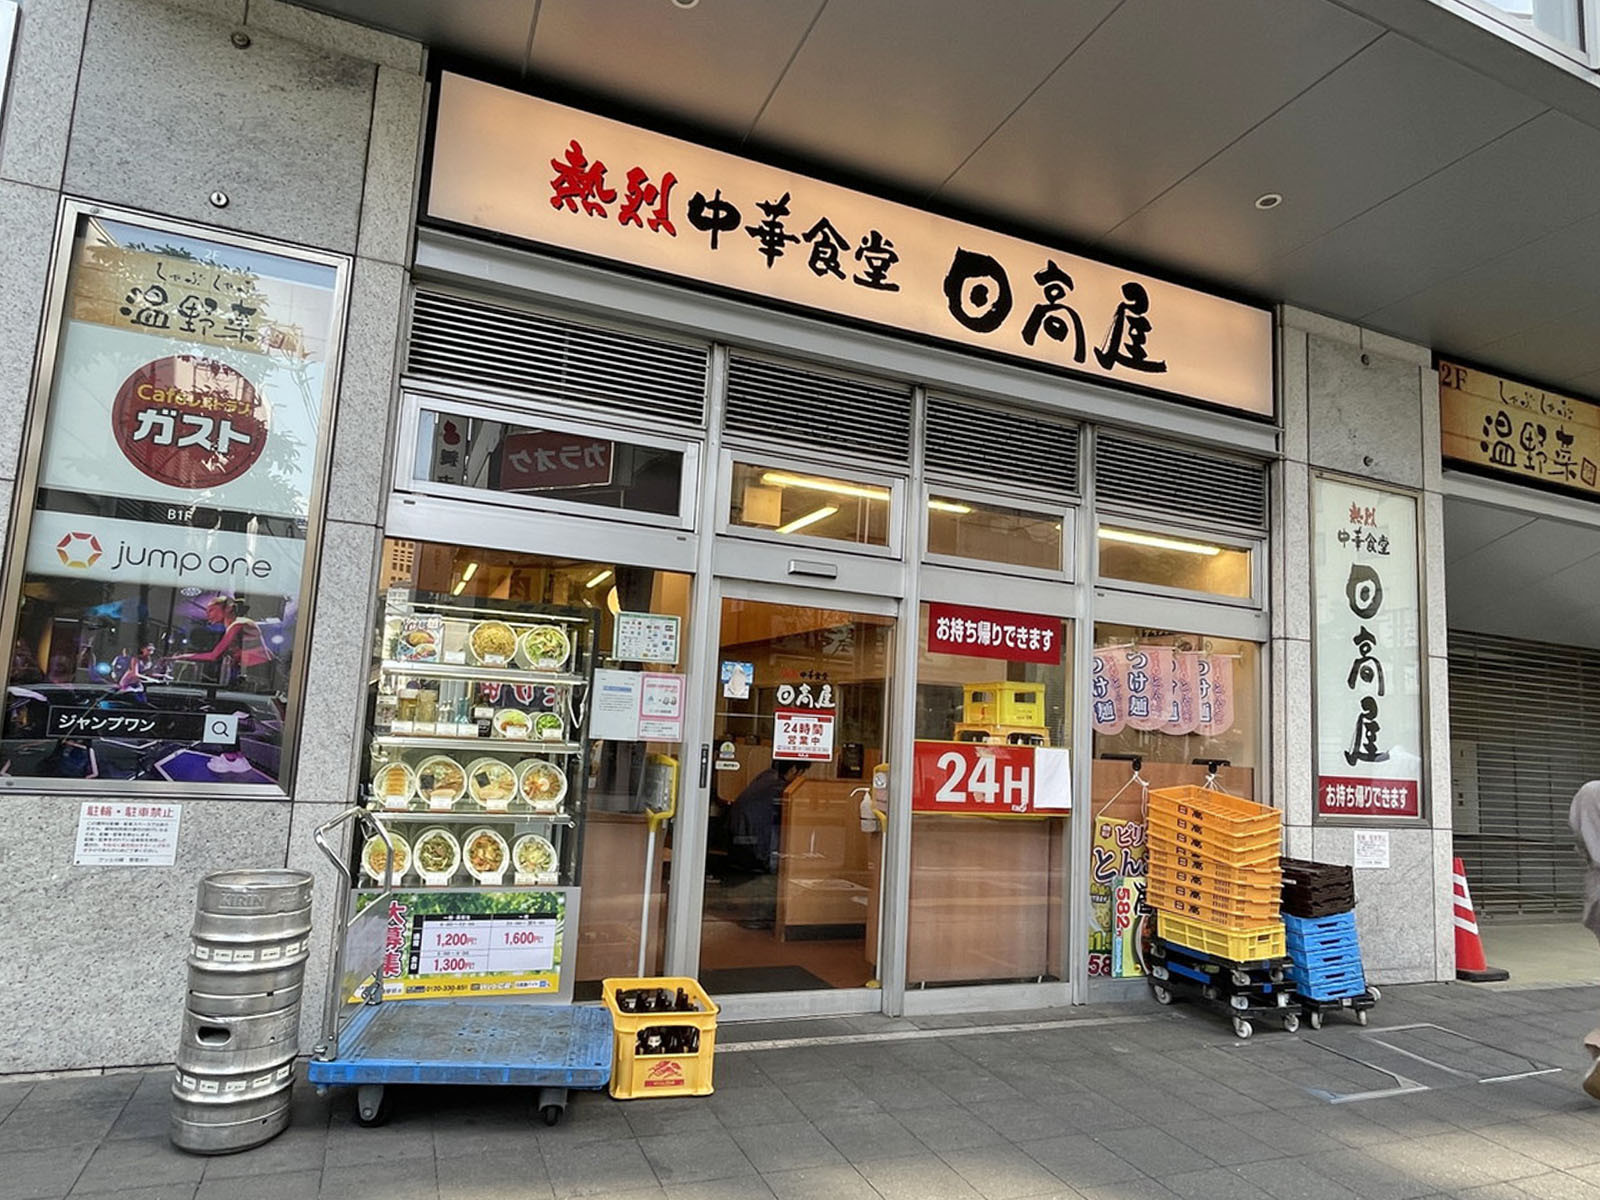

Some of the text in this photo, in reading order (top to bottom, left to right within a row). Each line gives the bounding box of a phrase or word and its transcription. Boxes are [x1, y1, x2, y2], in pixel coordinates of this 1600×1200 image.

[119, 285, 257, 343] 温野菜
[943, 246, 1167, 373] 日高屋
[1440, 363, 1468, 391] 2F
[1499, 380, 1574, 421] しゃぶしゃぶ
[132, 408, 251, 453] ガスト
[1480, 410, 1578, 482] 温野菜
[111, 541, 273, 578] jump one
[1337, 526, 1391, 556] 中華食堂
[936, 616, 1054, 652] お持ち帰りできます
[1344, 563, 1390, 767] 日高屋
[776, 683, 836, 709] 日高屋
[1126, 652, 1149, 718] つけ麺
[58, 713, 156, 732] ジャンプワン
[783, 721, 823, 737] 24時間
[787, 734, 820, 746] 営業中
[936, 751, 1031, 804] 24H
[1325, 783, 1408, 809] お持ち帰りできます
[1115, 821, 1149, 847] ピリ
[1093, 847, 1149, 884] とん
